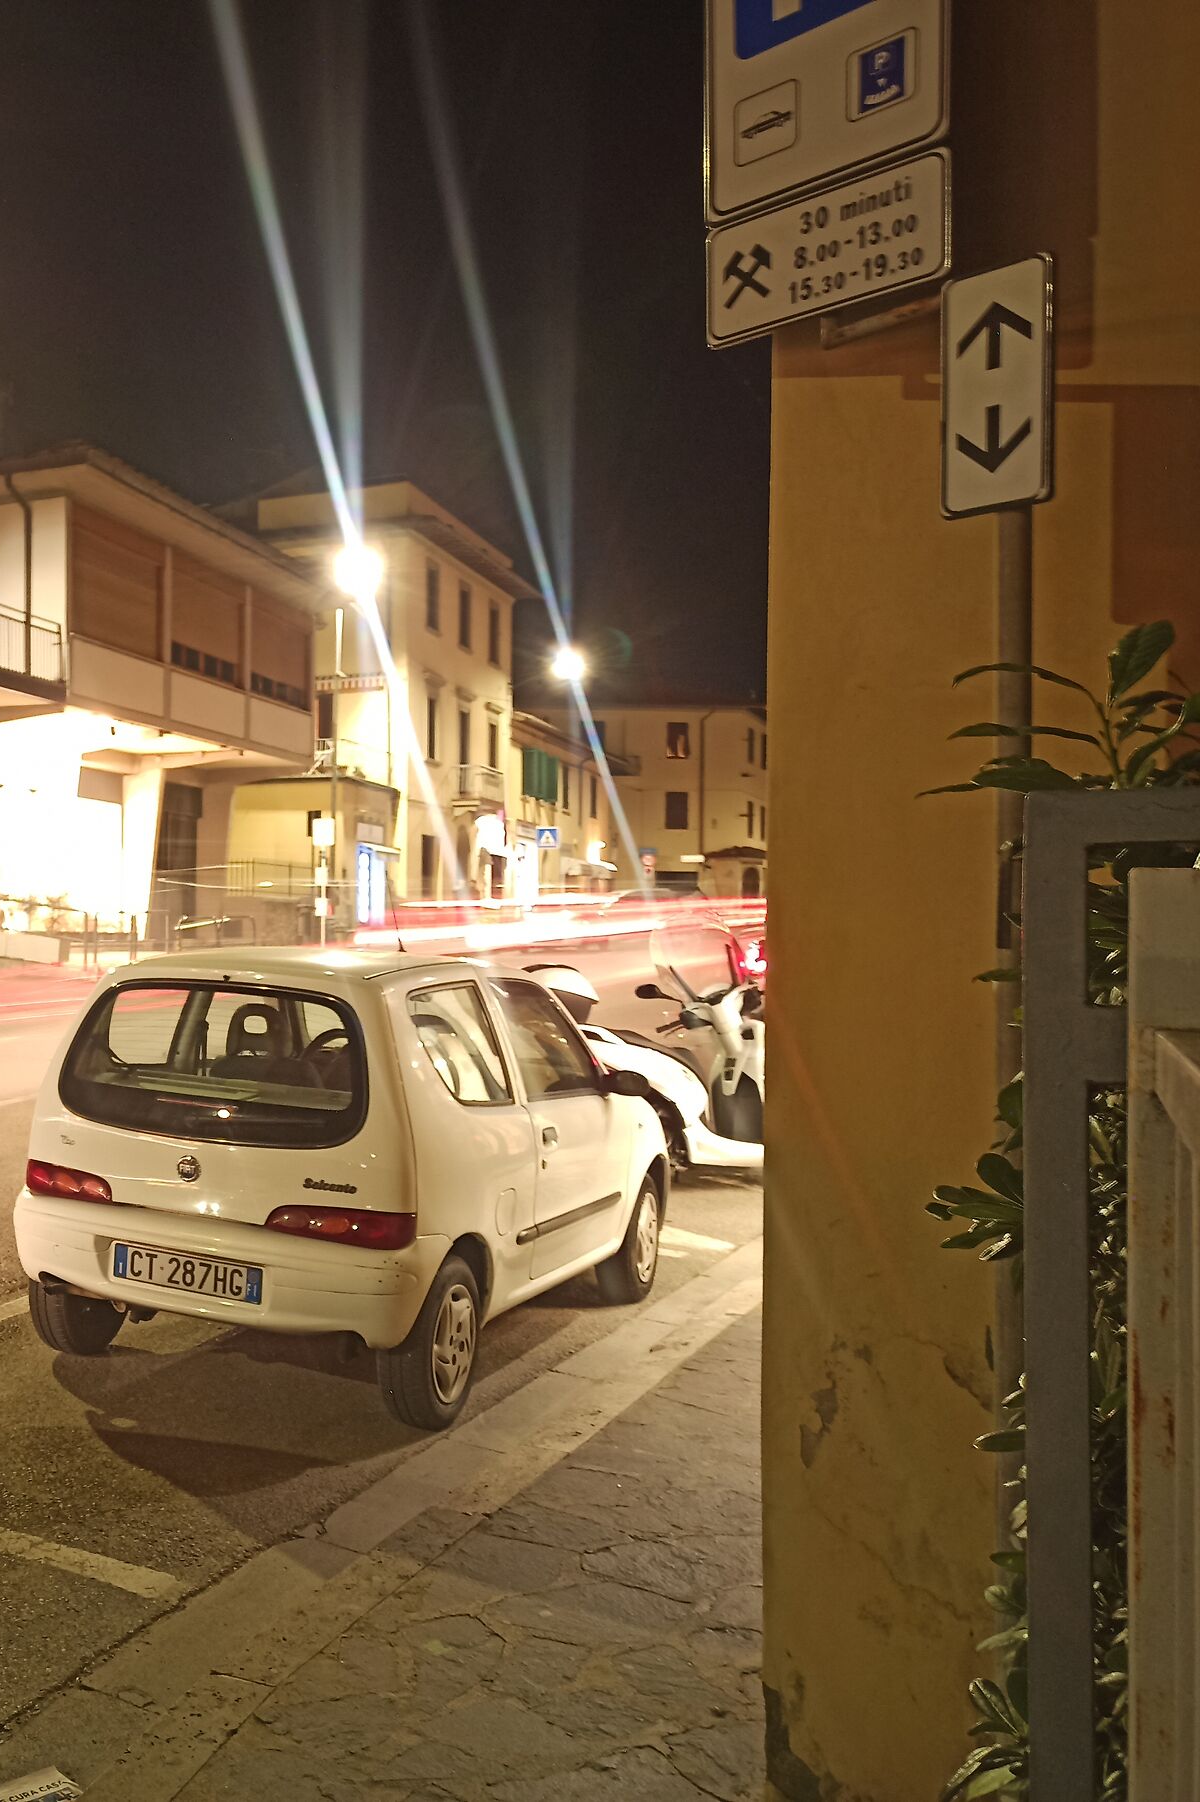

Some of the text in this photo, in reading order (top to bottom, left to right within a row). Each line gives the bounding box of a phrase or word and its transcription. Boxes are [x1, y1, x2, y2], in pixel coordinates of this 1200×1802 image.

[800, 176, 912, 234] 30 minuti
[793, 214, 918, 269] 8.00-13.00
[788, 247, 923, 304] 15.30-19.30
[130, 1250, 243, 1296] CT 287HG
